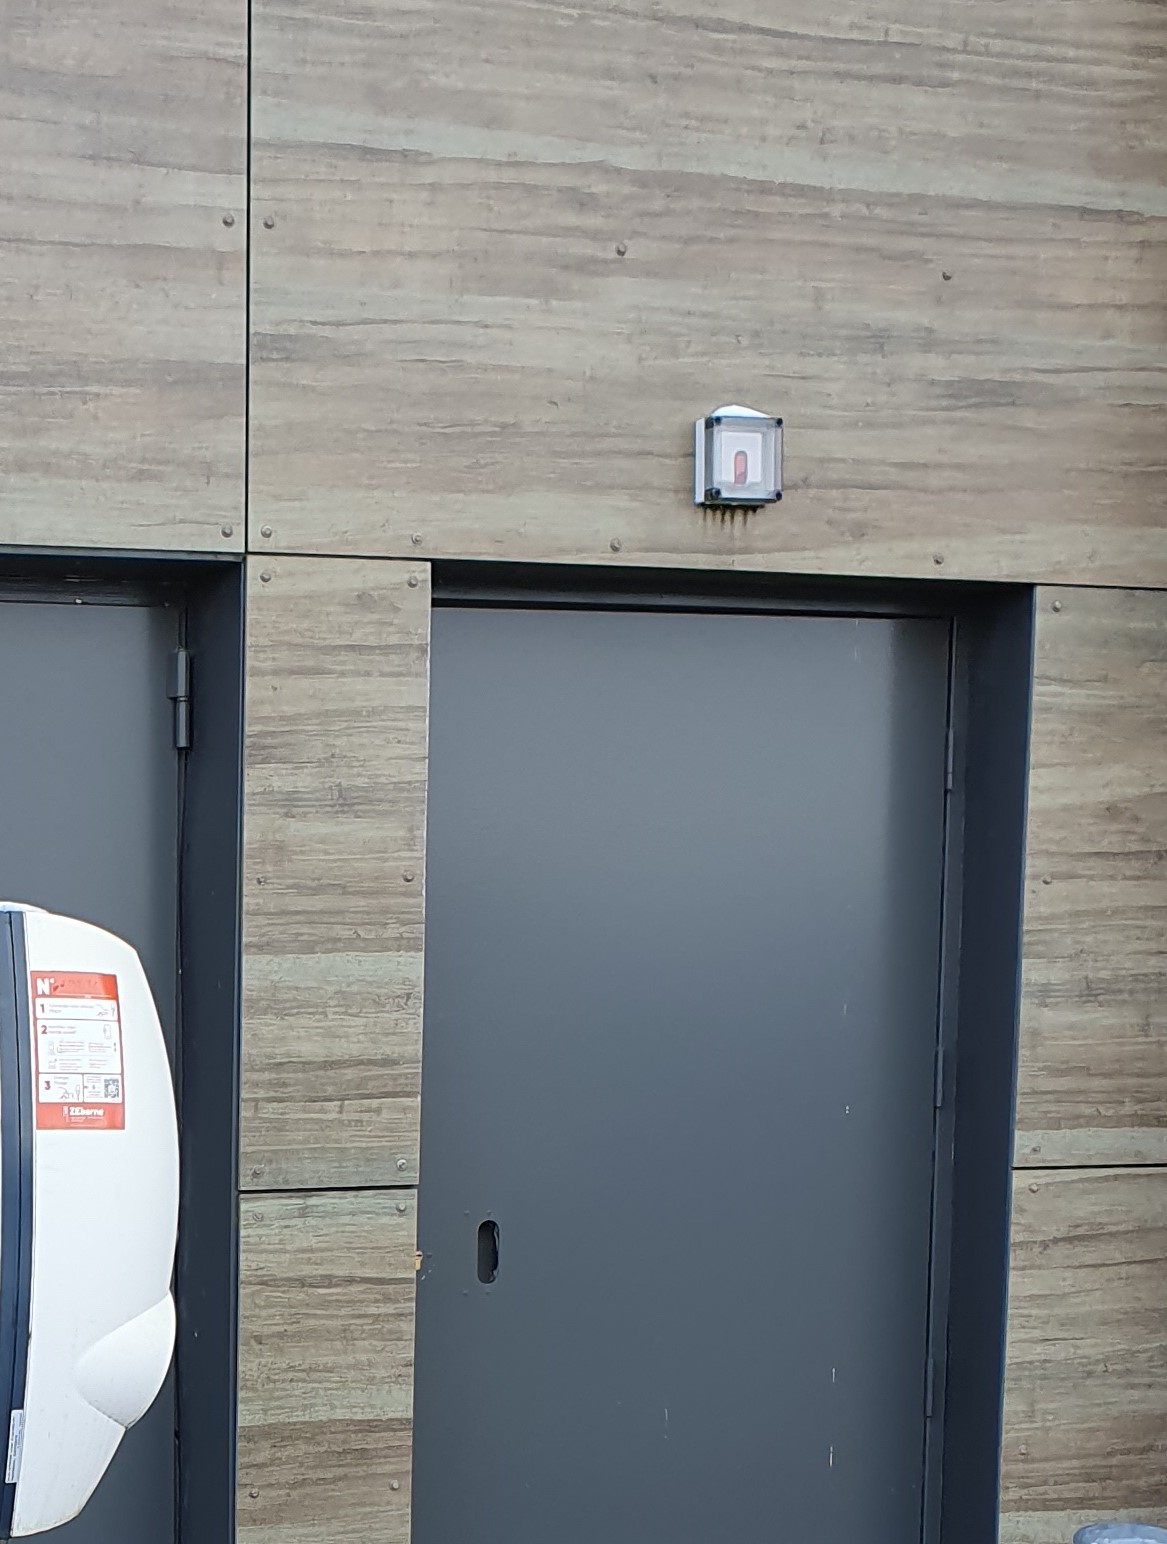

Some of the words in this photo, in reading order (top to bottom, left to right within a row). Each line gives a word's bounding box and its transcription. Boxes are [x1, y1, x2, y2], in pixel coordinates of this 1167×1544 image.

[39, 1003, 45, 1014] 1
[40, 1024, 48, 1035] 2
[44, 1080, 51, 1091] 3
